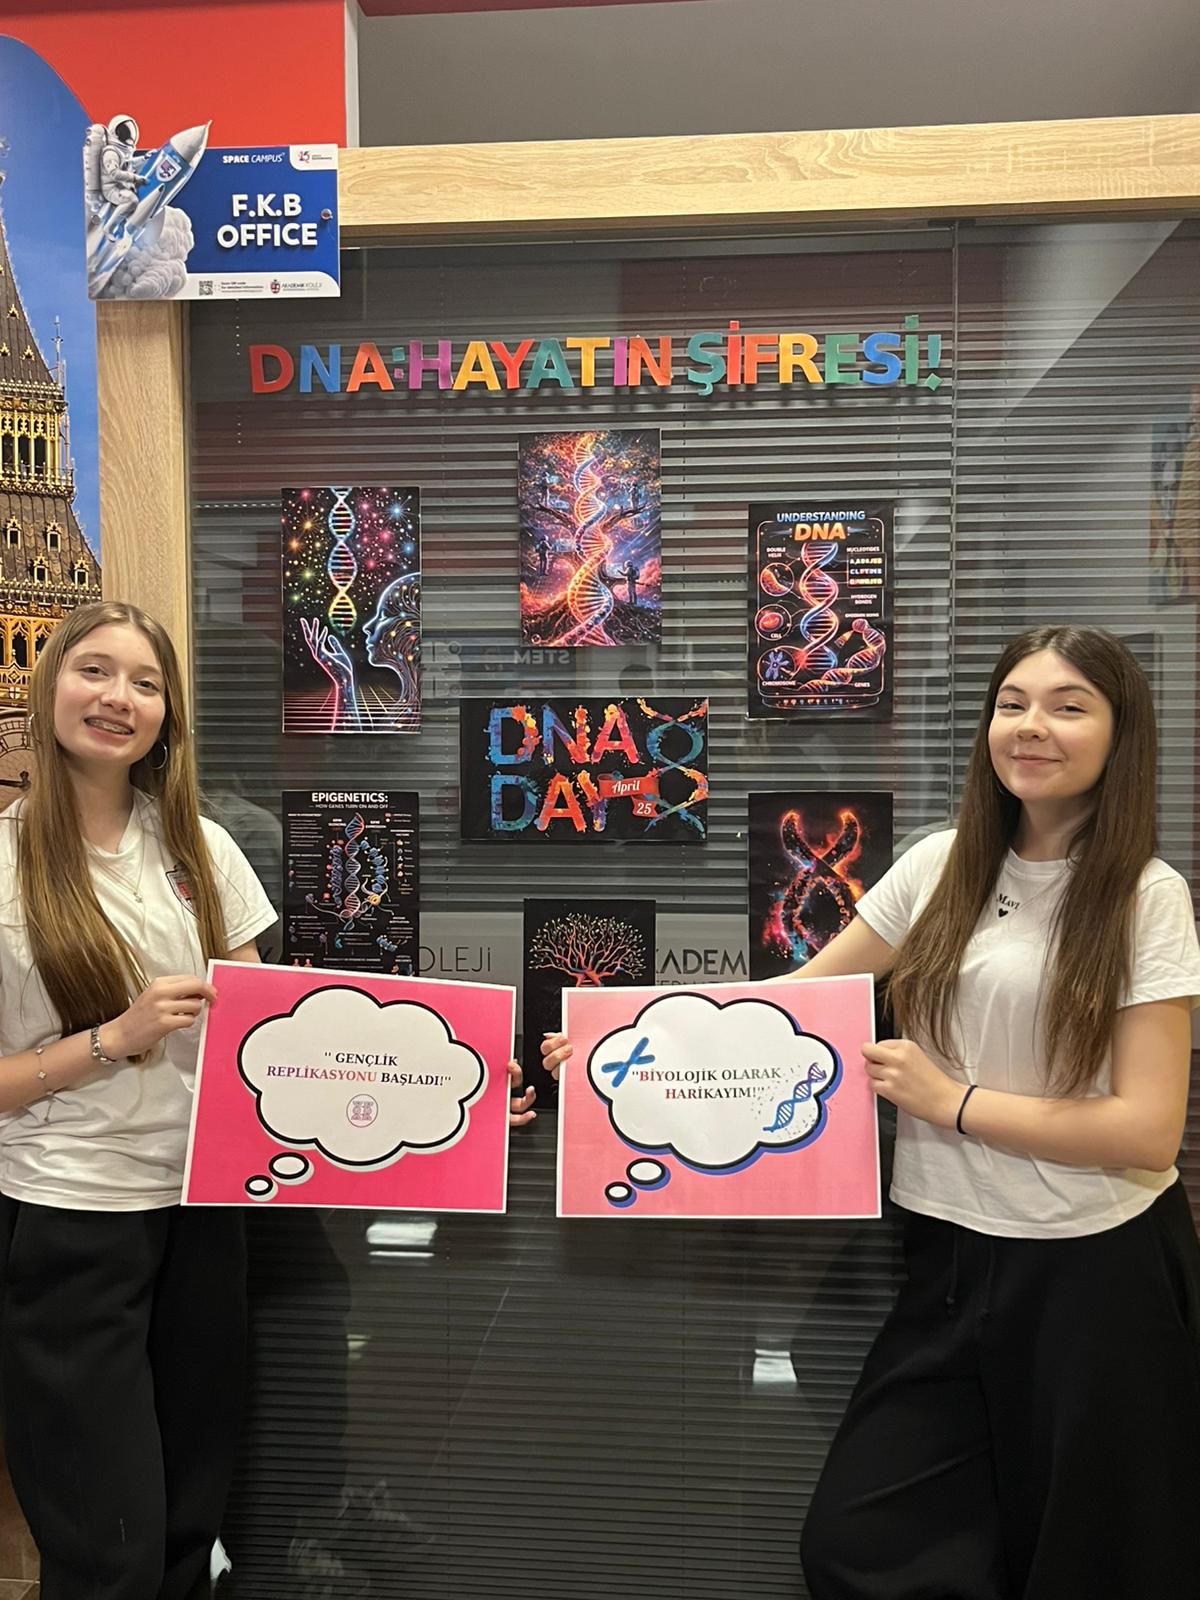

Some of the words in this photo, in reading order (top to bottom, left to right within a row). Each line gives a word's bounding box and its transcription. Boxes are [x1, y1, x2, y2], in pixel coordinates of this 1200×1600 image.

[222, 155, 249, 164] SPACE
[232, 194, 302, 218] F.K.B
[217, 223, 318, 248] OFFICE
[687, 314, 943, 396] ŞİFRESİ!
[776, 510, 866, 523] UNDERSTANDING
[794, 522, 847, 541] DNA
[487, 703, 641, 766] DNA
[611, 775, 642, 795] April
[311, 792, 389, 803] EPIGENETICS:
[490, 770, 609, 832] DAY
[636, 802, 652, 815] 25
[655, 948, 748, 975] ADEM
[335, 1051, 398, 1068] GENÇLİK
[267, 1064, 377, 1083] REPLİKASYONU
[721, 1067, 782, 1081] OLARAK
